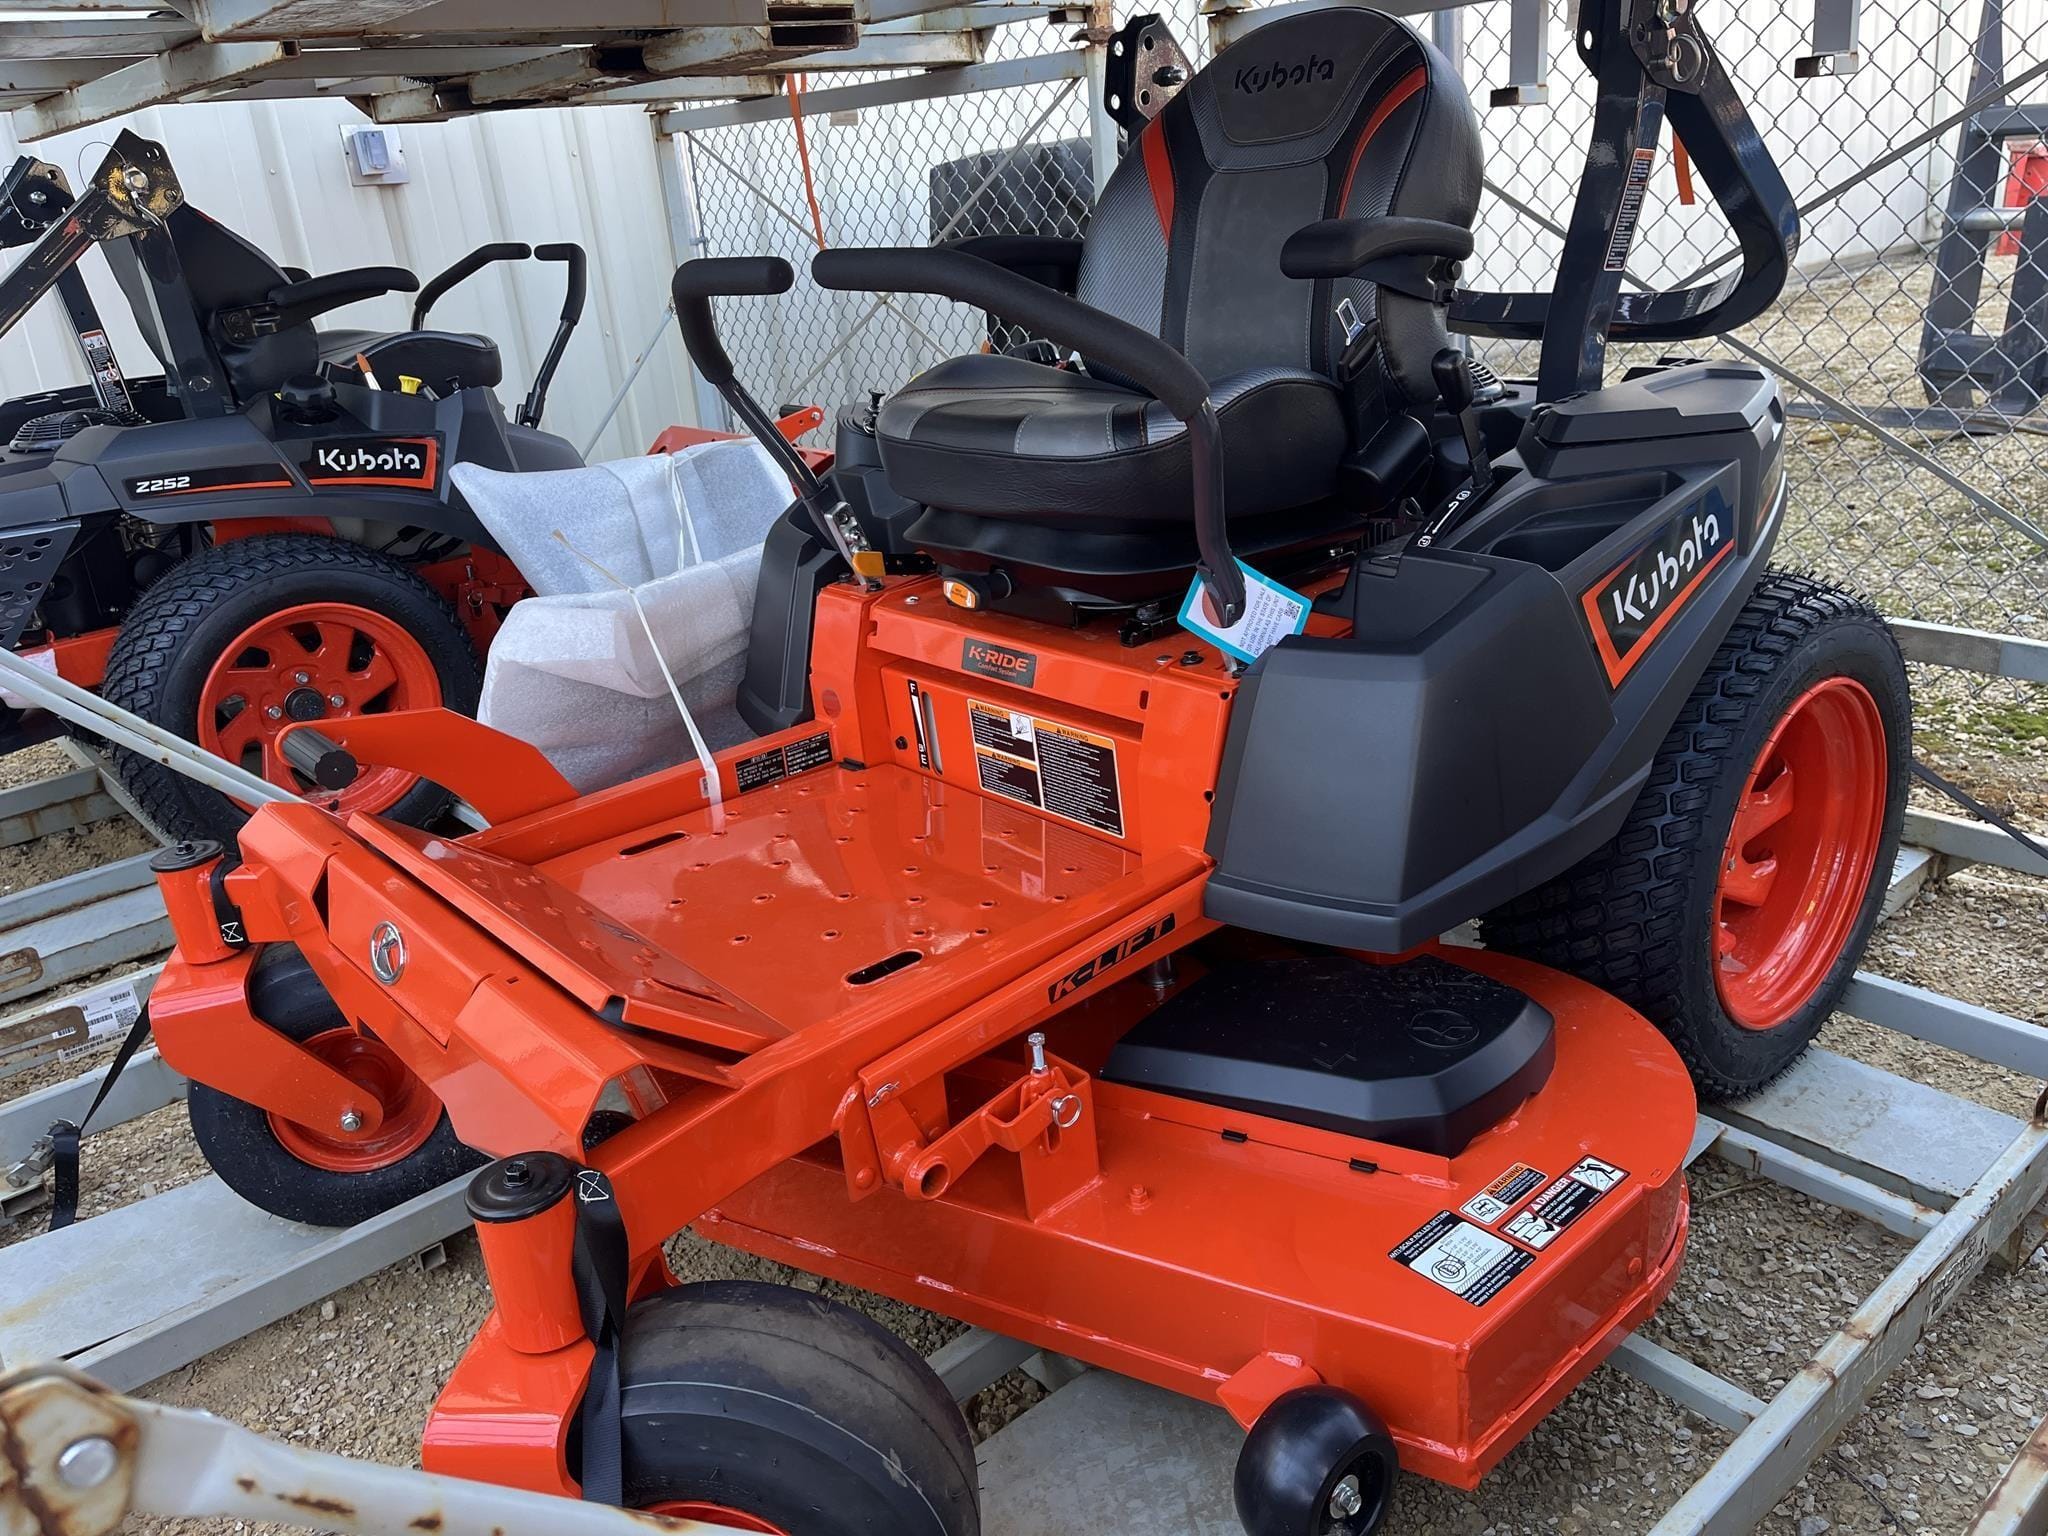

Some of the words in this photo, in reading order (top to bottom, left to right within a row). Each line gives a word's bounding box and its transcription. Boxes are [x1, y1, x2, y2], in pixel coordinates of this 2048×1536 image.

[1235, 54, 1334, 94] Kubota
[318, 447, 421, 472] Kubota
[135, 475, 191, 494] Z252
[1612, 513, 1721, 625] Kubota
[968, 645, 1029, 672] K-RIDE
[909, 682, 916, 693] F
[920, 754, 928, 765] E
[1053, 915, 1171, 1001] K-LIFT
[1493, 1166, 1524, 1190] WARNING
[1536, 1177, 1570, 1204] DANGER
